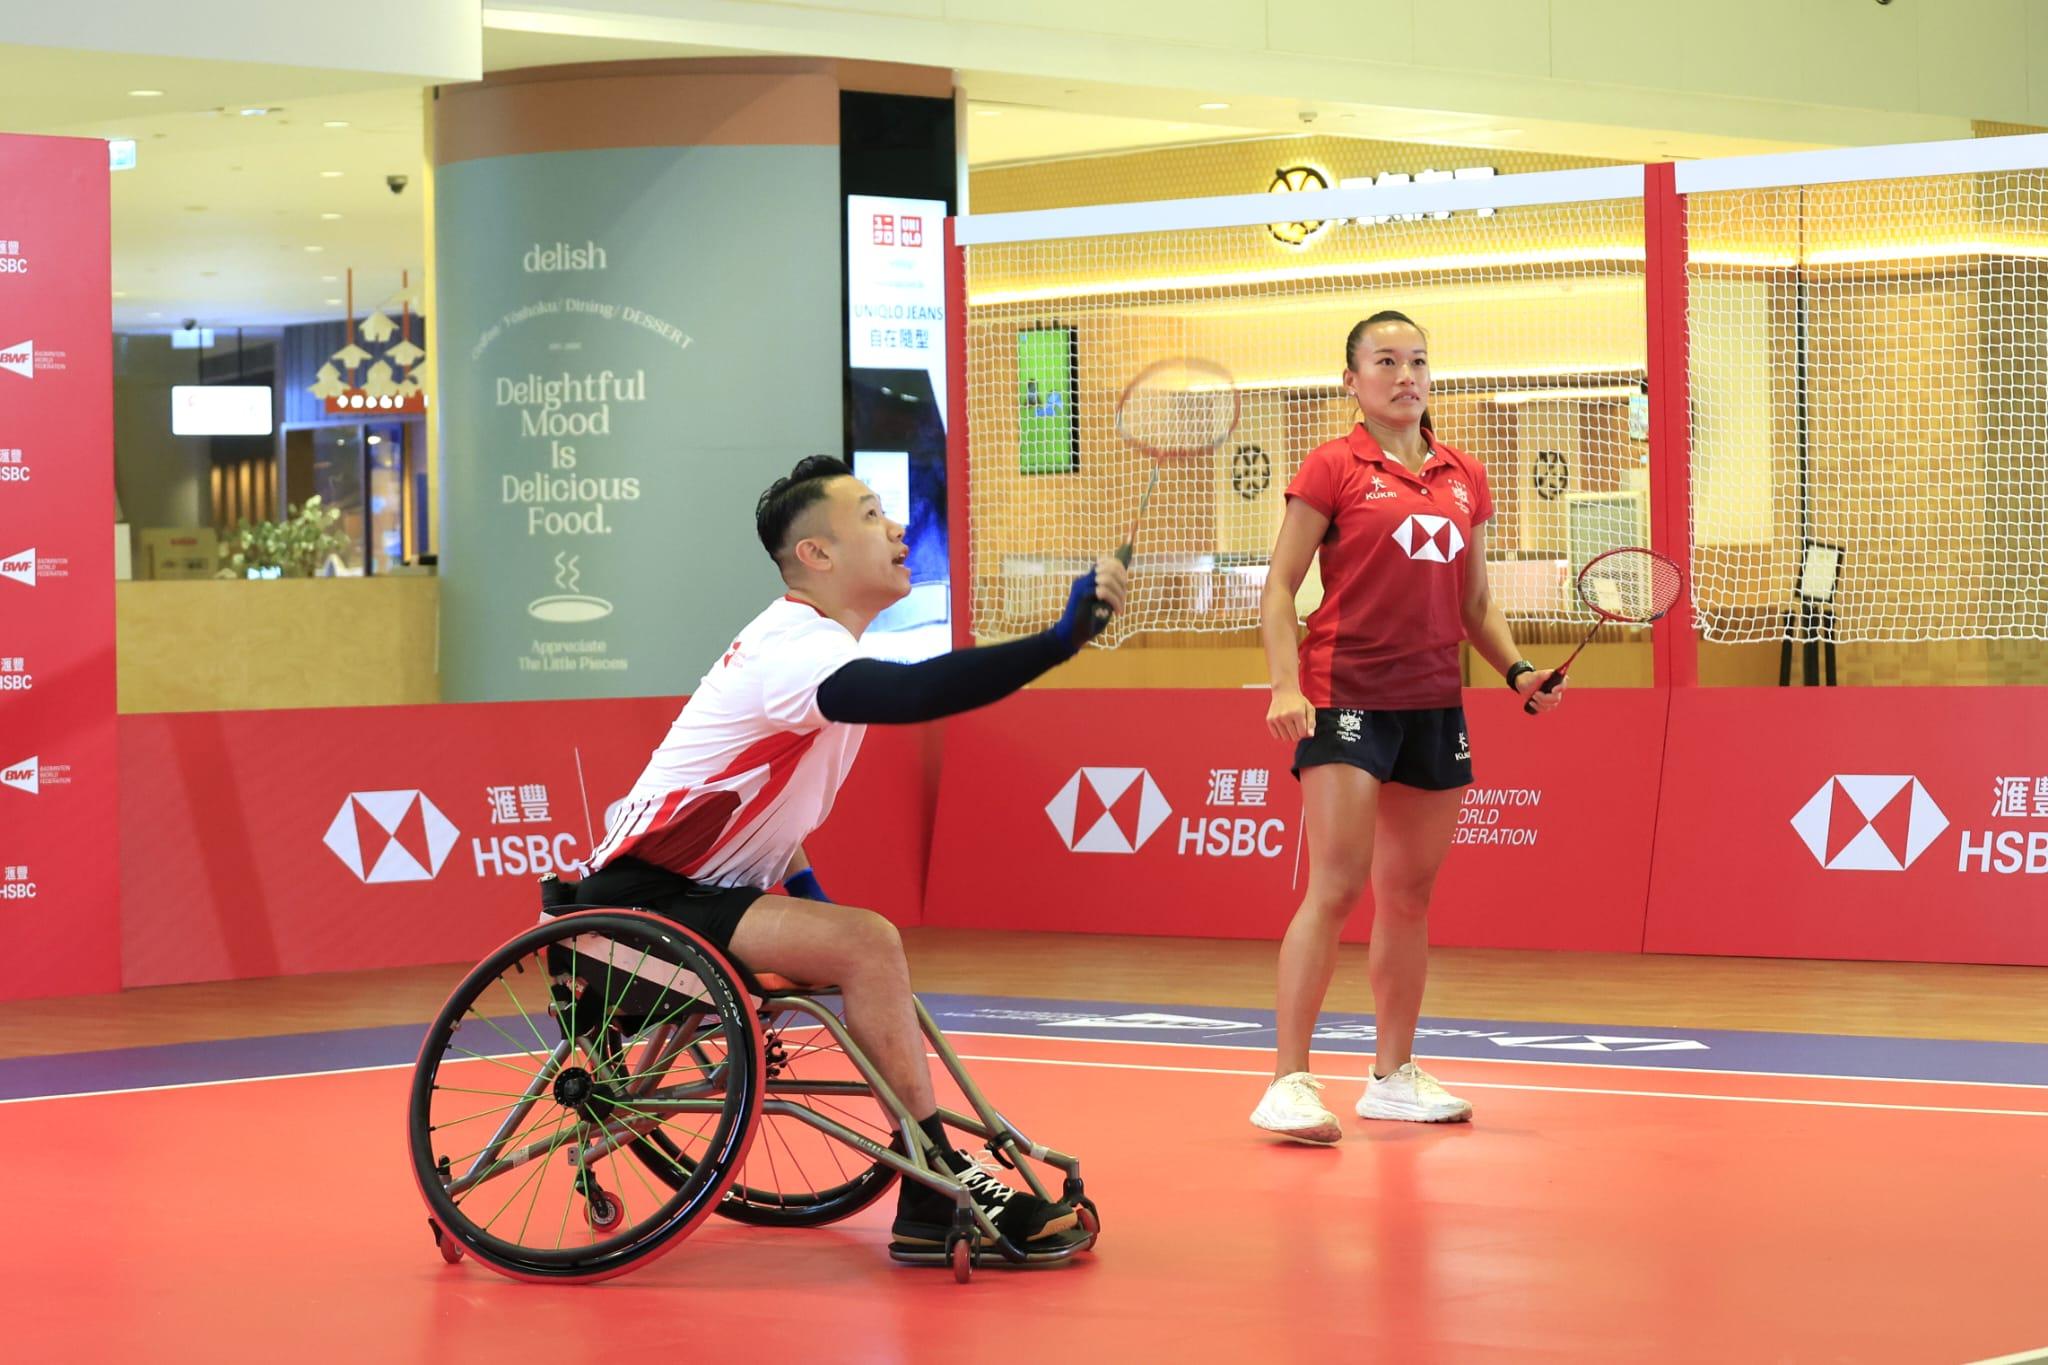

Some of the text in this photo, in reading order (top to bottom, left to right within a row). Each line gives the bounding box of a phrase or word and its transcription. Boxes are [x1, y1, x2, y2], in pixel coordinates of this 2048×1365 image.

[523, 241, 608, 272] delish
[0, 258, 28, 273] SBC
[854, 304, 944, 321] UNIQLO JEANS
[622, 306, 694, 349] DESSERT
[0, 353, 29, 364] BWF
[496, 369, 647, 411] Delightful
[521, 404, 610, 437] Mood
[552, 440, 577, 469] Is
[0, 466, 30, 481] SBC
[502, 472, 641, 504] Delicious
[1366, 491, 1398, 500] KUKRI
[528, 503, 613, 536] Food.
[2, 561, 32, 572] BWF
[532, 639, 607, 655] Appreciate
[518, 656, 629, 671] The Little Pieces
[5, 769, 35, 781] BWF
[1461, 789, 1541, 806] DMINTON
[1457, 808, 1500, 824] ORLD
[1178, 817, 1285, 857] HSBC
[1451, 828, 1538, 845] DERATION
[472, 832, 579, 877] HSBC
[1958, 830, 2048, 874] HSB
